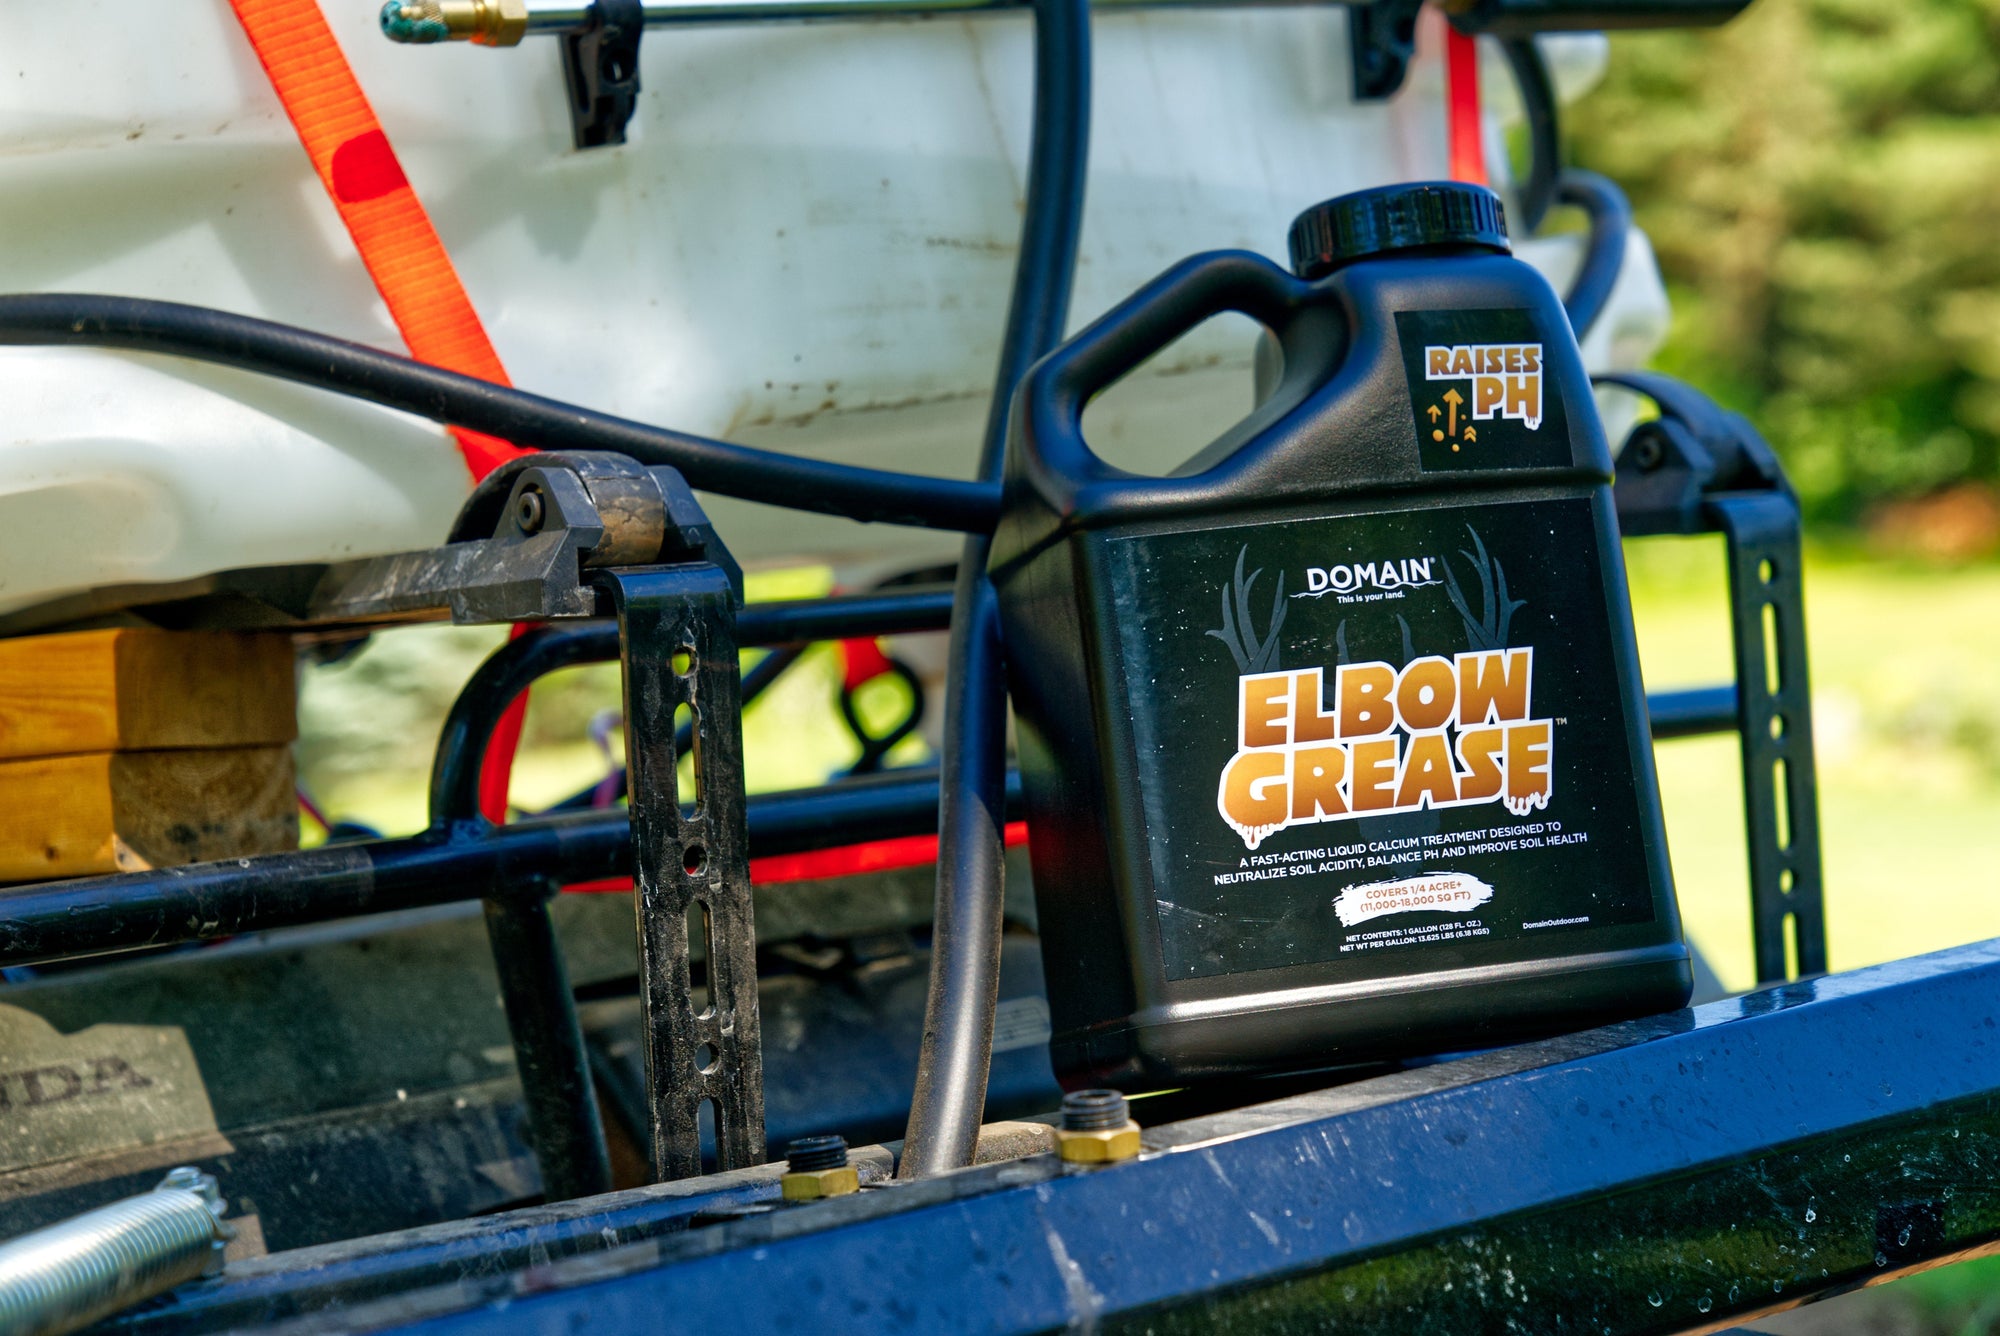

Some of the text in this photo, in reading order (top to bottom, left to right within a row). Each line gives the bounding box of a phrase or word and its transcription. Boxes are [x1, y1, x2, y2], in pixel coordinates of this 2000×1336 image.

[1425, 344, 1542, 379] RAISES
[1474, 375, 1542, 430] PH
[1336, 590, 1405, 604] This is your land.
[1239, 646, 1533, 751] ELBOW
[1218, 718, 1553, 850] GREASE
[1214, 832, 1587, 885] NEUTRALIZE SOIL ACIDITY, BALANCE PH AND IMPROVE SOIL HEALTH
[1240, 821, 1561, 868] A FAST-ACTING LIQUID CALCIUM TREATMENT DESIGNED TO
[1360, 891, 1471, 913] (11,000-18,000 SQ FT)
[1366, 881, 1462, 899] COVERS 1/4 ACRE+
[1340, 927, 1490, 952] NET WT PER GALLON: 13.625 LBS (6.18 KGS)
[1346, 934, 1361, 943] NET
[1362, 929, 1402, 941] CONTENTS:
[1408, 925, 1438, 935] GALLON
[1439, 922, 1453, 932] (128
[1455, 921, 1465, 930] FL.
[1466, 920, 1481, 928] OZ.)
[1522, 916, 1589, 930] DomainOutdoor.com
[0, 1056, 152, 1110] DA
